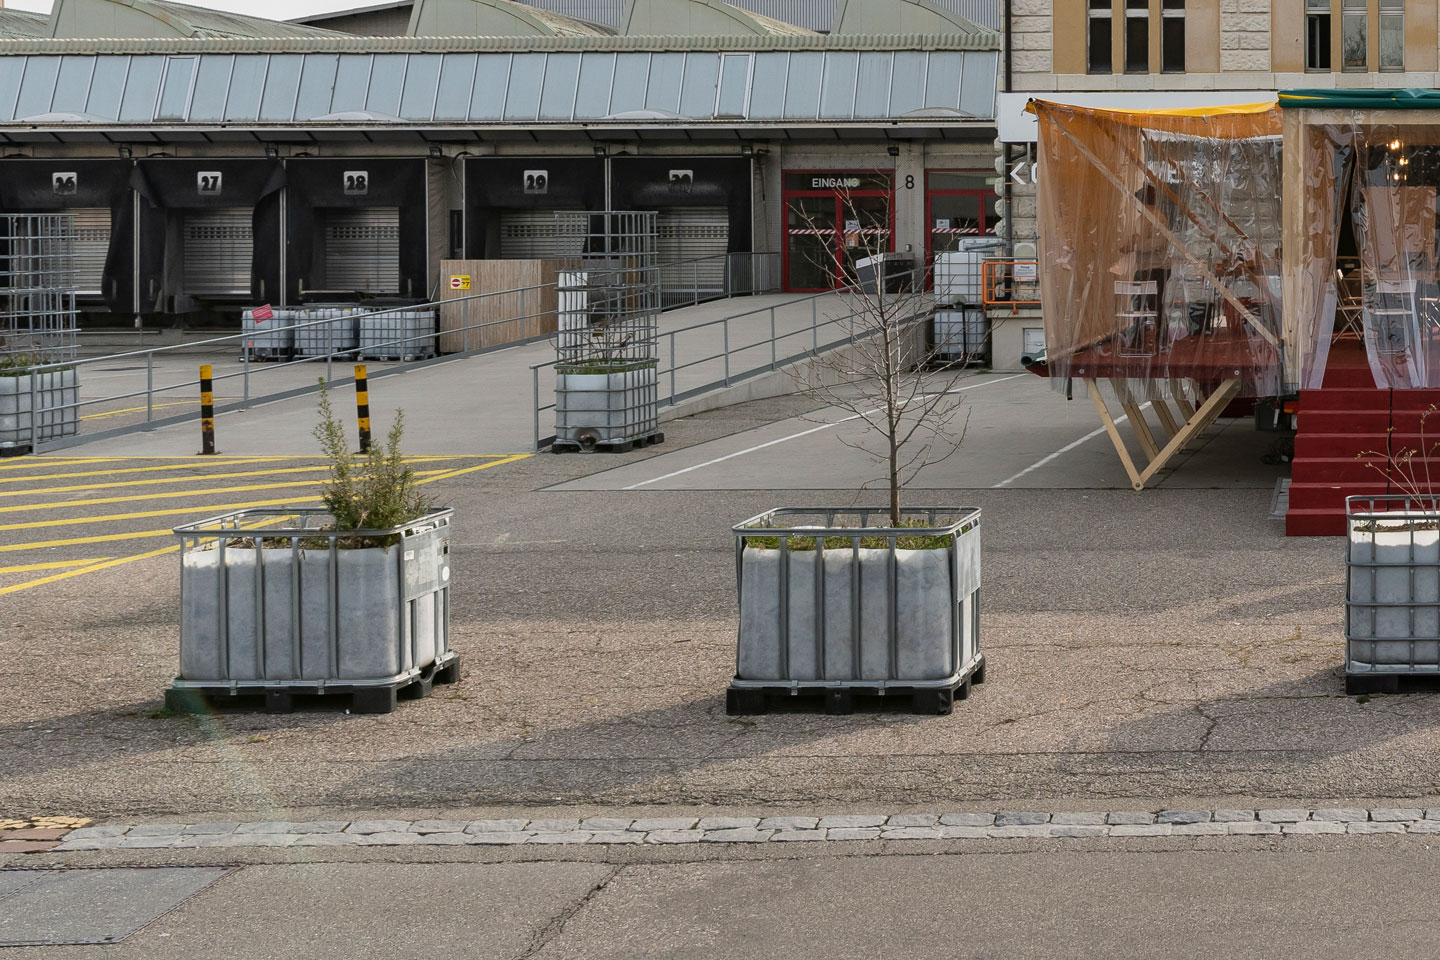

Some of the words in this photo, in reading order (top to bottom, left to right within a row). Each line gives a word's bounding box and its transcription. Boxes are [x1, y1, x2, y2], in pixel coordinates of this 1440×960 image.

[56, 176, 75, 192] 26
[201, 175, 219, 191] 27
[347, 175, 366, 190] 28
[526, 174, 546, 189] 29
[812, 178, 860, 188] EINGANG
[905, 174, 915, 189] 8
